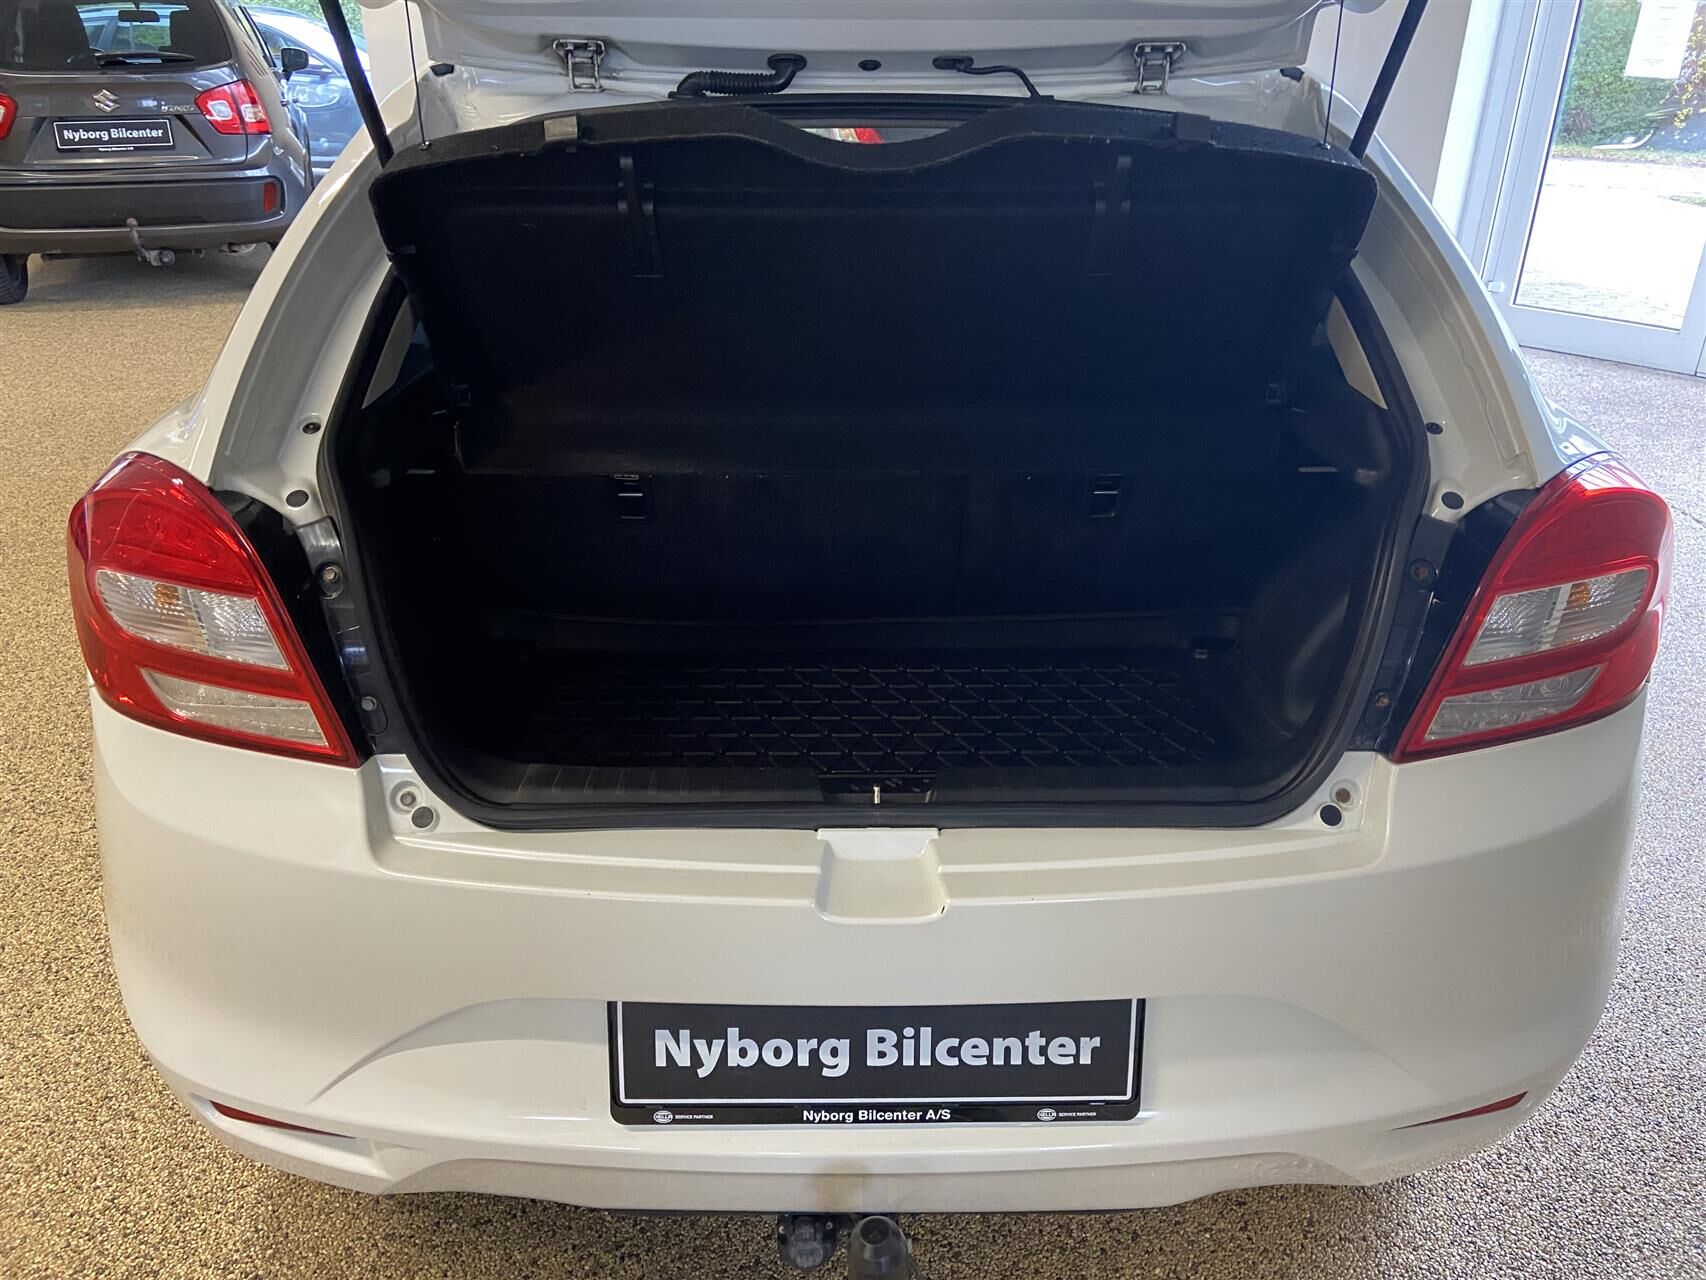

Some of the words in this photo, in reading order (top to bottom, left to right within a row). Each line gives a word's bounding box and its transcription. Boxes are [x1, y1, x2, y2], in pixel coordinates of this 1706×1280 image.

[63, 129, 109, 141] Nyborg
[110, 128, 163, 138] Bilcenter
[654, 1028, 850, 1078] Nyborg
[866, 1027, 1101, 1067] Bilcenter
[803, 1110, 853, 1123] Nyborg
[858, 1110, 922, 1121] Bilcenter
[926, 1109, 951, 1120] A/S
